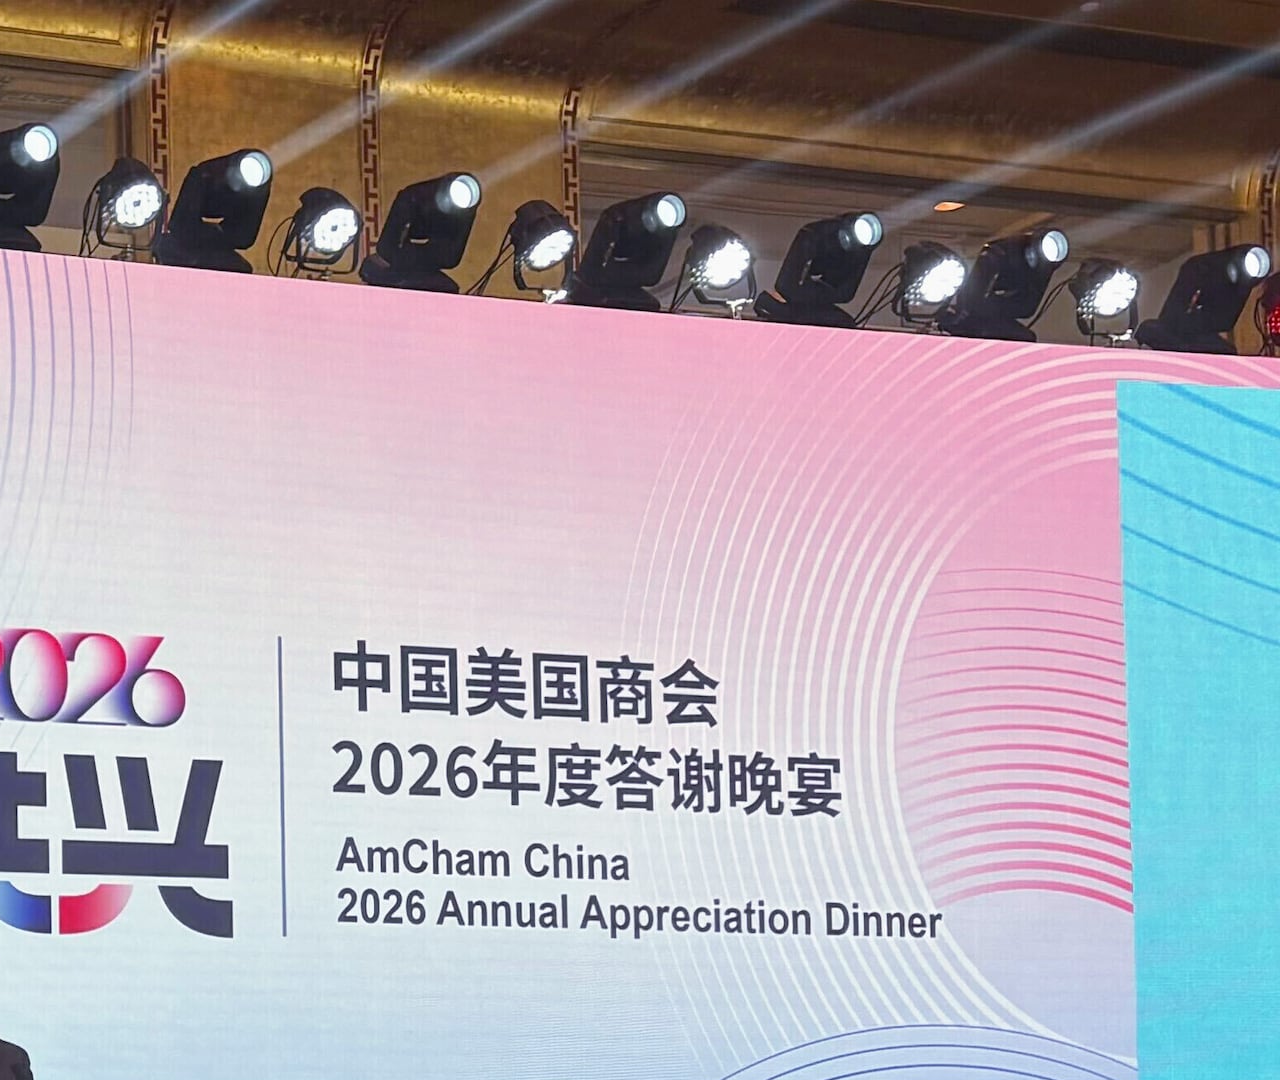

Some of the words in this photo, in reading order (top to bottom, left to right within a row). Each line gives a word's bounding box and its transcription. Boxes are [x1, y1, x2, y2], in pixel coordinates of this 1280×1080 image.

[332, 640, 721, 728] 中国美国商会
[332, 738, 843, 820] 2026年度答谢晚宴
[336, 836, 512, 878] AmCham
[524, 842, 631, 881] China
[337, 887, 426, 926] 2026
[436, 890, 569, 930] Annual
[580, 894, 813, 939] Appreciation
[825, 901, 944, 938] Dinner
